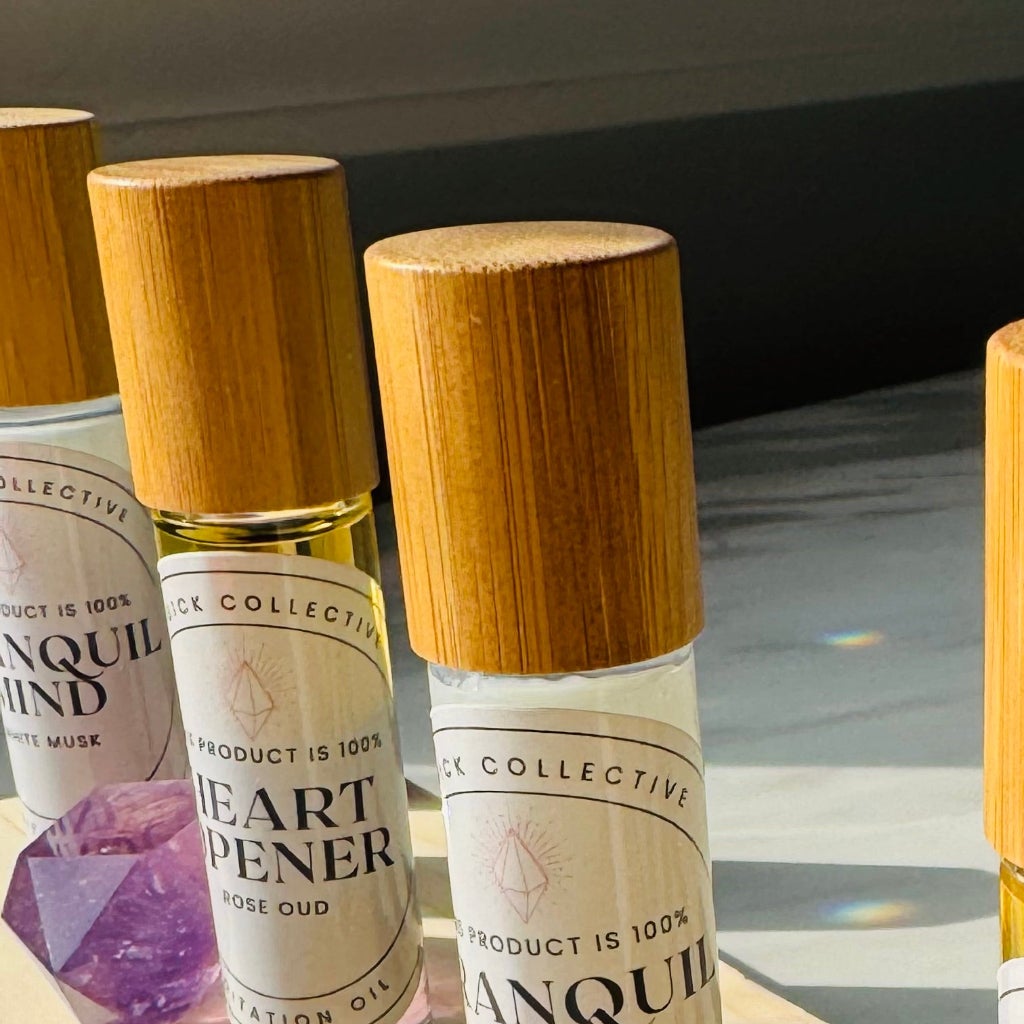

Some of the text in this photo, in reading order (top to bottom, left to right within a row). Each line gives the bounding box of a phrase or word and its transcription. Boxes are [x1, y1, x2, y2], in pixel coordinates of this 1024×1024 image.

[58, 603, 77, 618] IS
[86, 593, 132, 615] 100%
[0, 618, 162, 680] NQUIL
[47, 733, 102, 749] MUSK
[309, 745, 330, 763] IS
[338, 731, 383, 758] 100%
[481, 756, 689, 808] COLLECTIVE
[200, 823, 395, 884] PENER
[222, 889, 330, 916] ROSE OUD
[468, 926, 581, 956] PRODUCT
[595, 931, 620, 952] IS
[632, 906, 689, 943] 100%
[350, 979, 390, 1012] OIL
